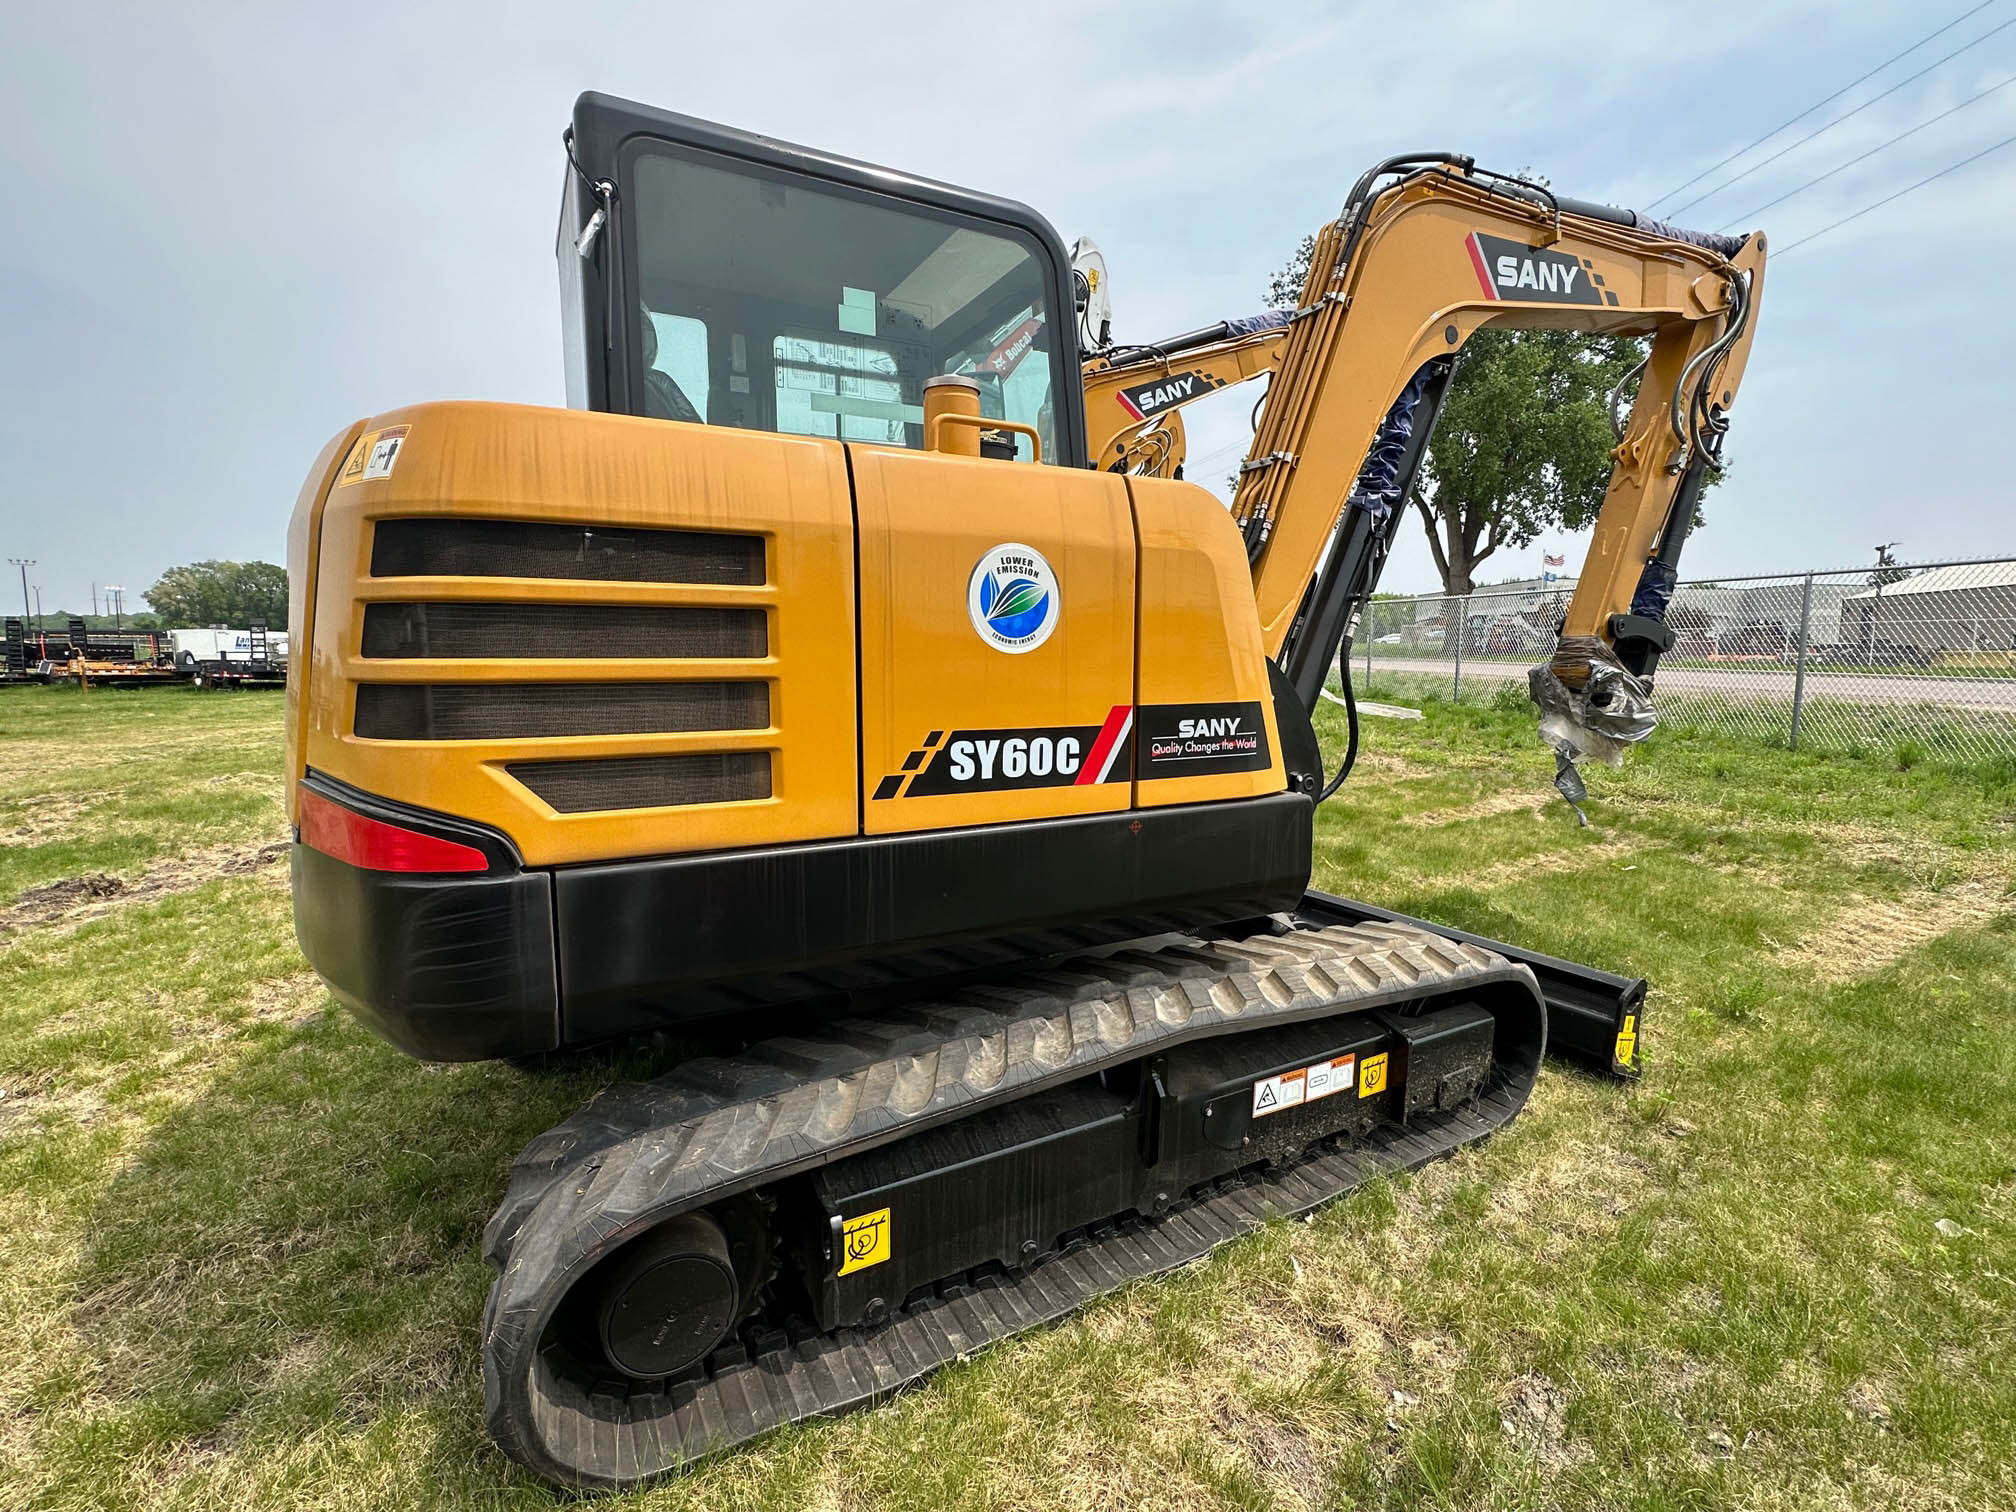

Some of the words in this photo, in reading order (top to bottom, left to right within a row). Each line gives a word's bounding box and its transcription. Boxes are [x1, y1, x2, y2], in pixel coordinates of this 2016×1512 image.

[1497, 255, 1579, 294] SANY
[1138, 376, 1193, 411] SANY
[996, 565, 1040, 579] EMISSION
[1000, 557, 1034, 567] LOWER
[1178, 717, 1241, 739] SANY
[1151, 741, 1183, 756] Quality
[1185, 741, 1220, 754] Changes
[1221, 739, 1234, 750] the
[1235, 737, 1257, 749] World
[949, 737, 1080, 781] SY60C
